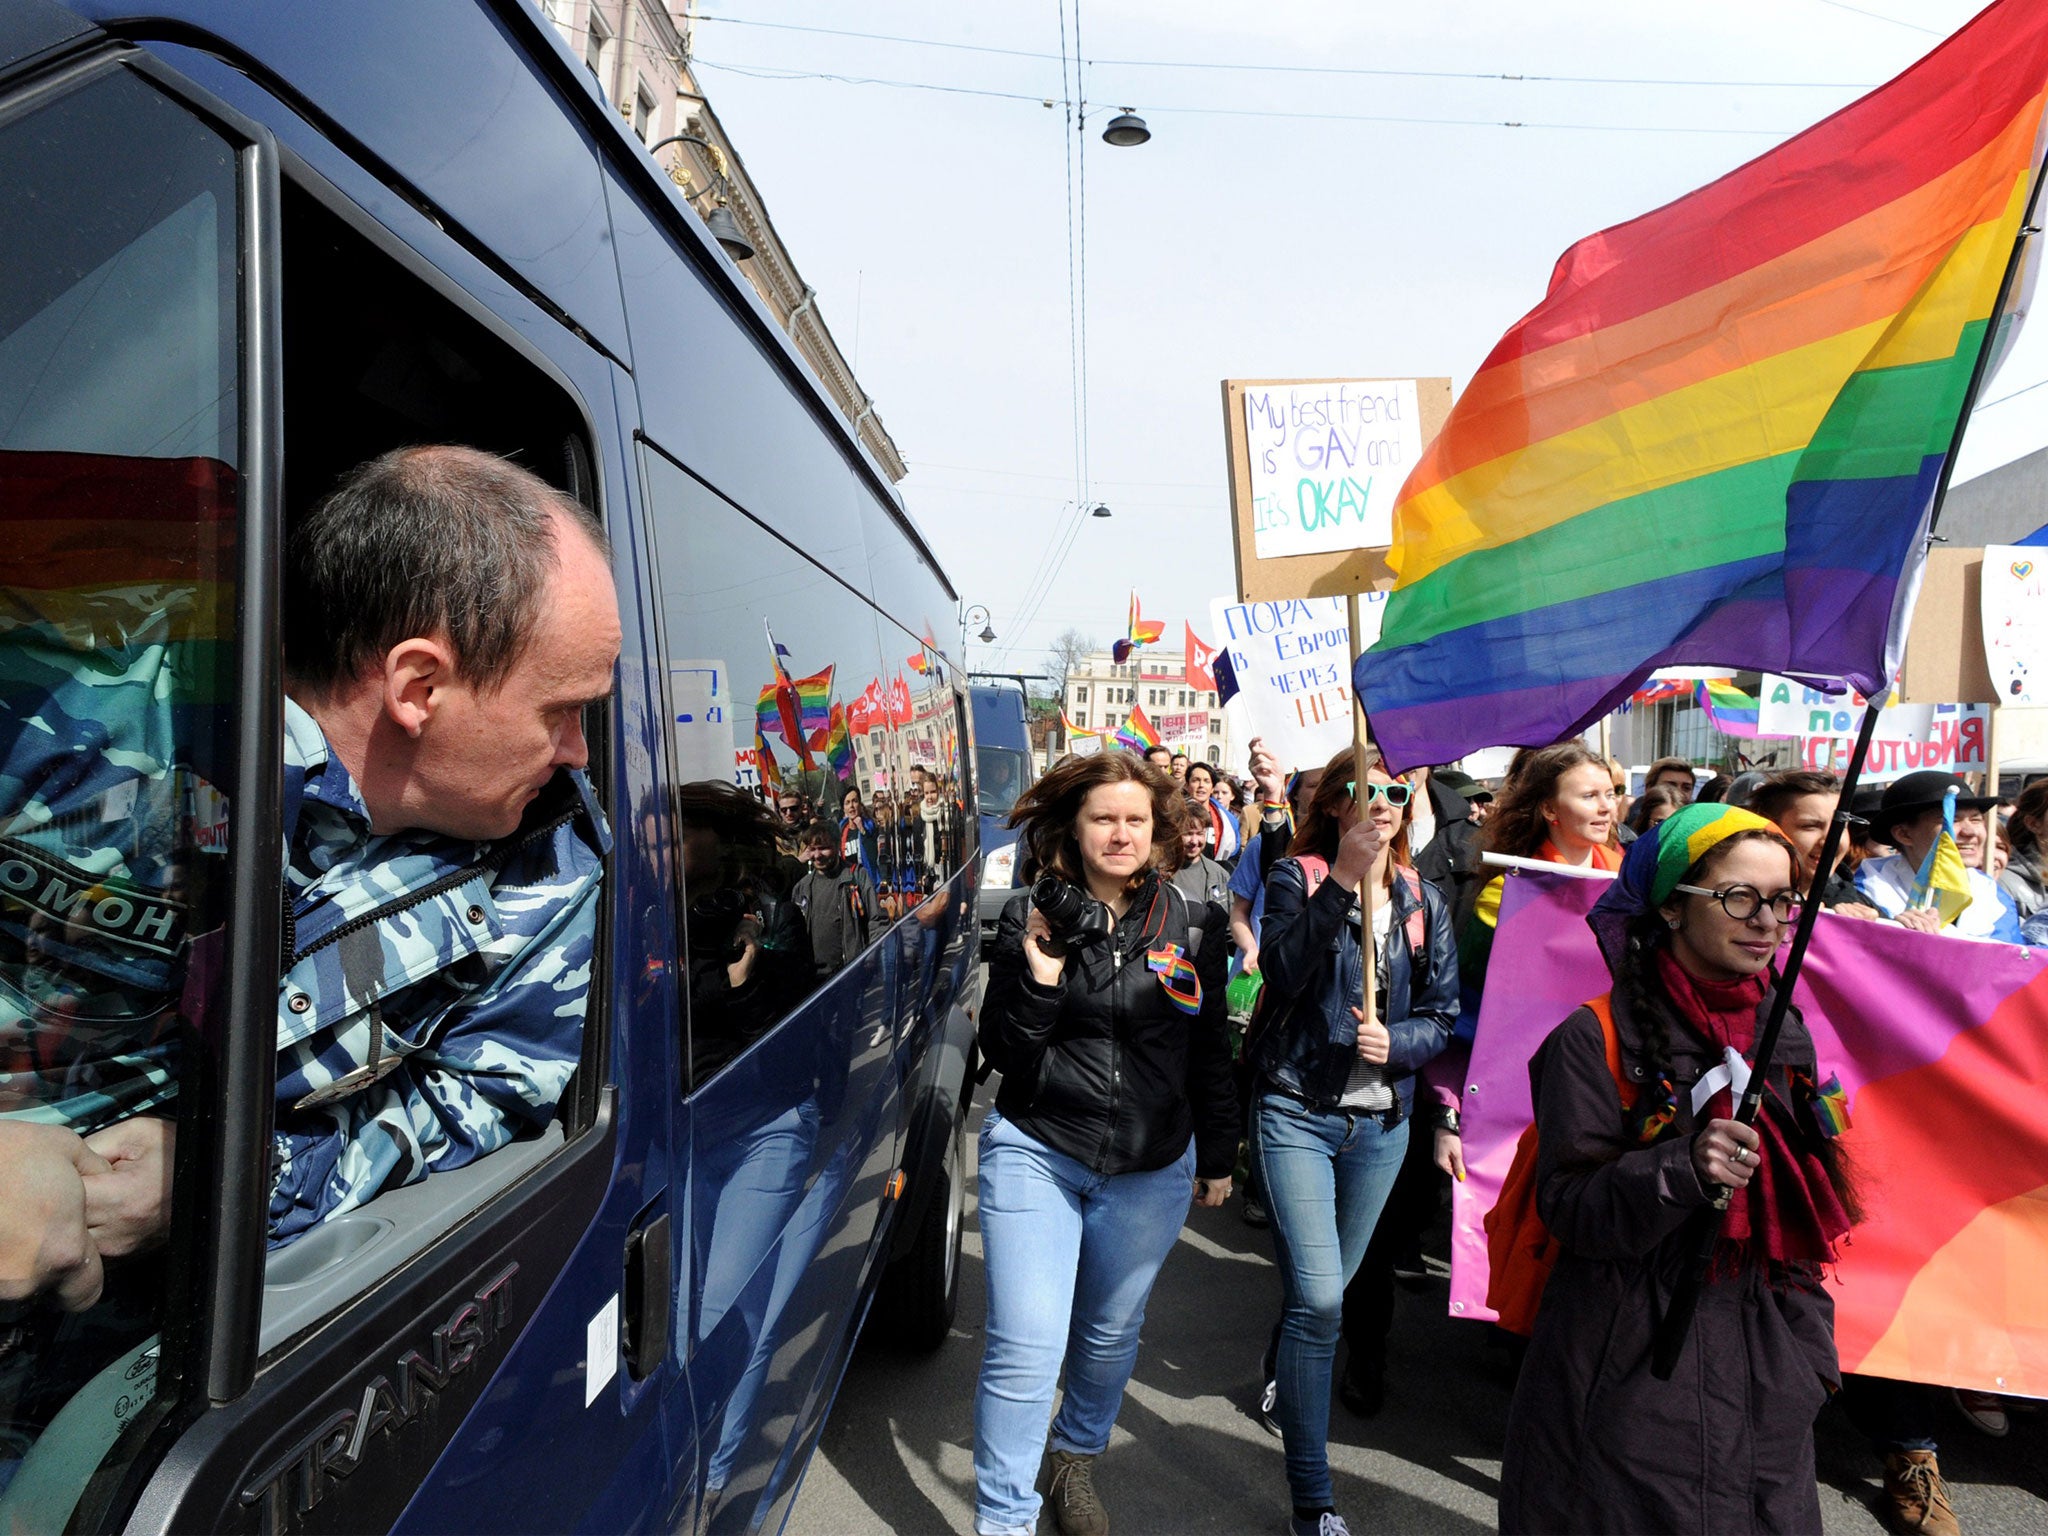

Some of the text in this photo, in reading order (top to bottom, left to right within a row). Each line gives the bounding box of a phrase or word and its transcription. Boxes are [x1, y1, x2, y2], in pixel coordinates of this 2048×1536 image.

[1249, 384, 1402, 447] My best friend
[1261, 425, 1402, 475] is GAY and
[1254, 475, 1373, 533] It's OKAY
[1224, 598, 1313, 640] ПОРА
[1232, 651, 1249, 672] В
[1274, 626, 1351, 661] ЕВРОП
[1270, 662, 1338, 694] ЧЕРЕЗ
[1770, 682, 1790, 704] А
[0, 859, 177, 942] ОМОН
[241, 1261, 520, 1536] TRANSIT
